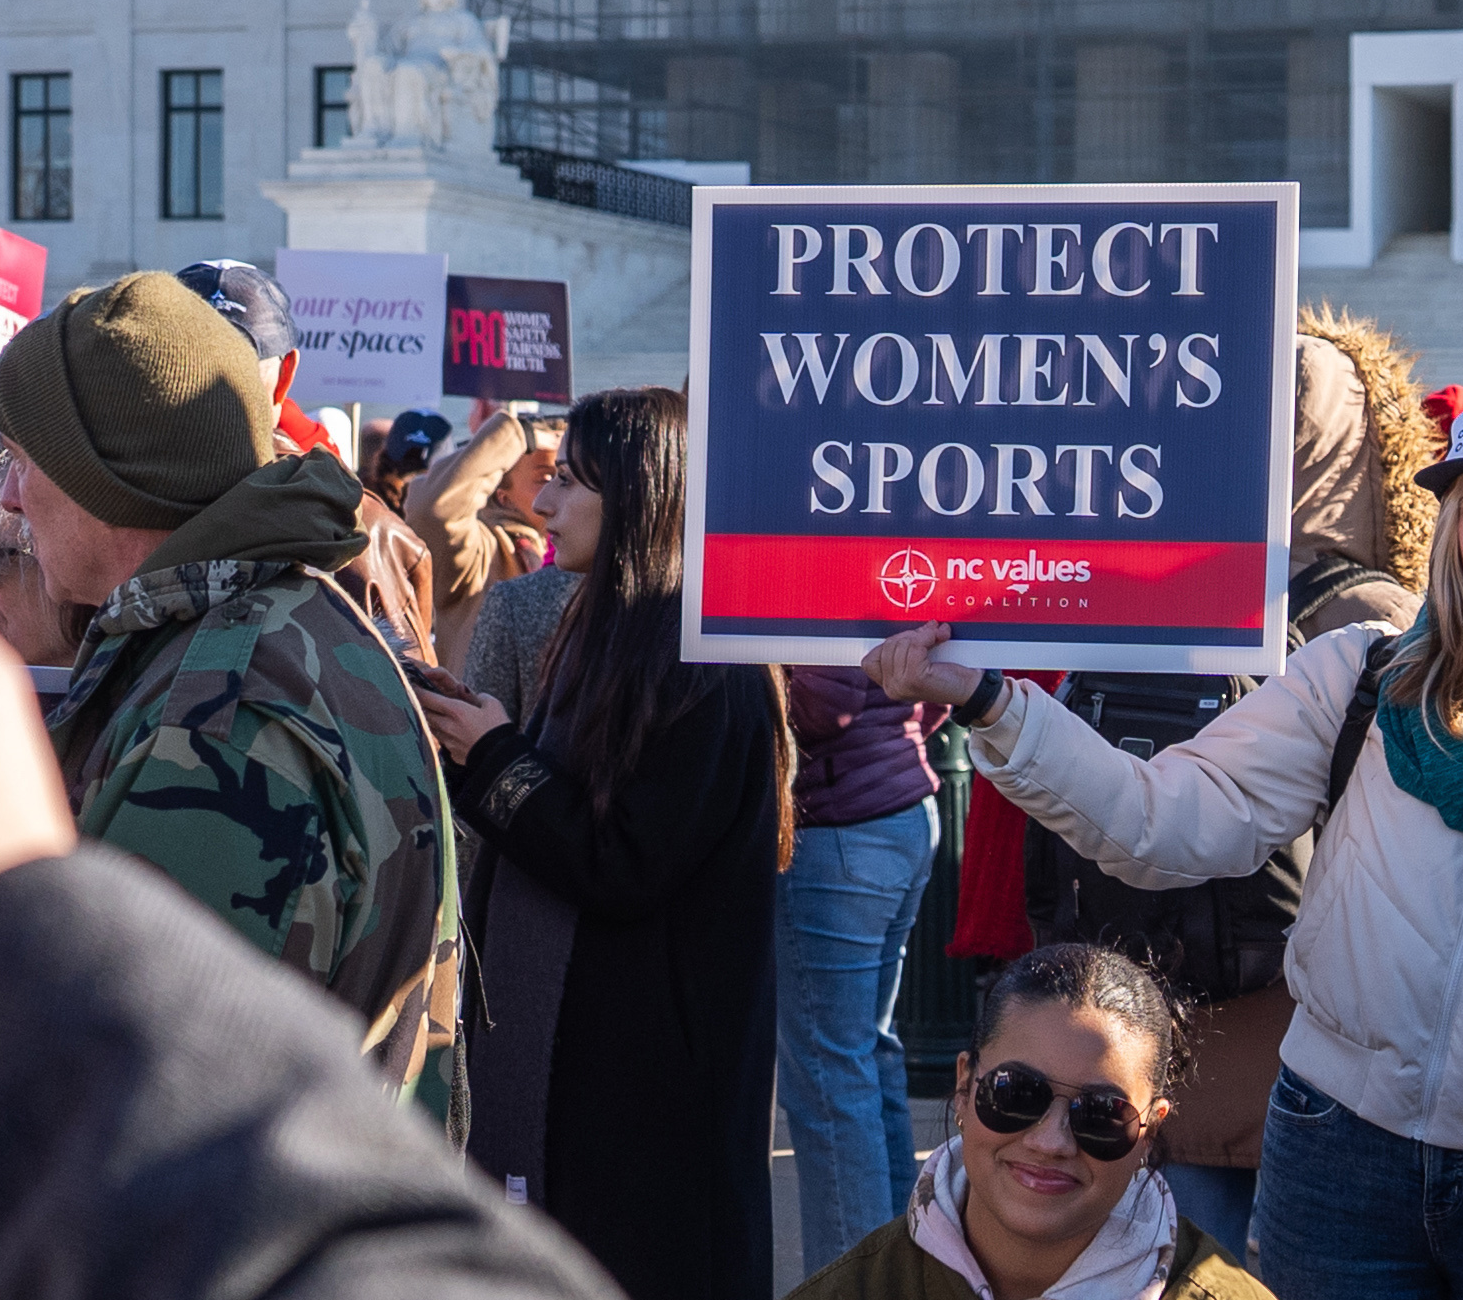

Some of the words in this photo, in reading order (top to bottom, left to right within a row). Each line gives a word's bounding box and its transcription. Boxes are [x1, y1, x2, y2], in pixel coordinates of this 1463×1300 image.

[770, 223, 1219, 297] PROTECT
[293, 297, 338, 319] our
[340, 295, 425, 326] sports
[338, 330, 426, 359] spaces
[450, 308, 506, 368] PRO
[810, 440, 1164, 518] SPORTS
[946, 558, 984, 581] nc
[990, 549, 1091, 585] values
[946, 595, 1089, 608] COALITION
